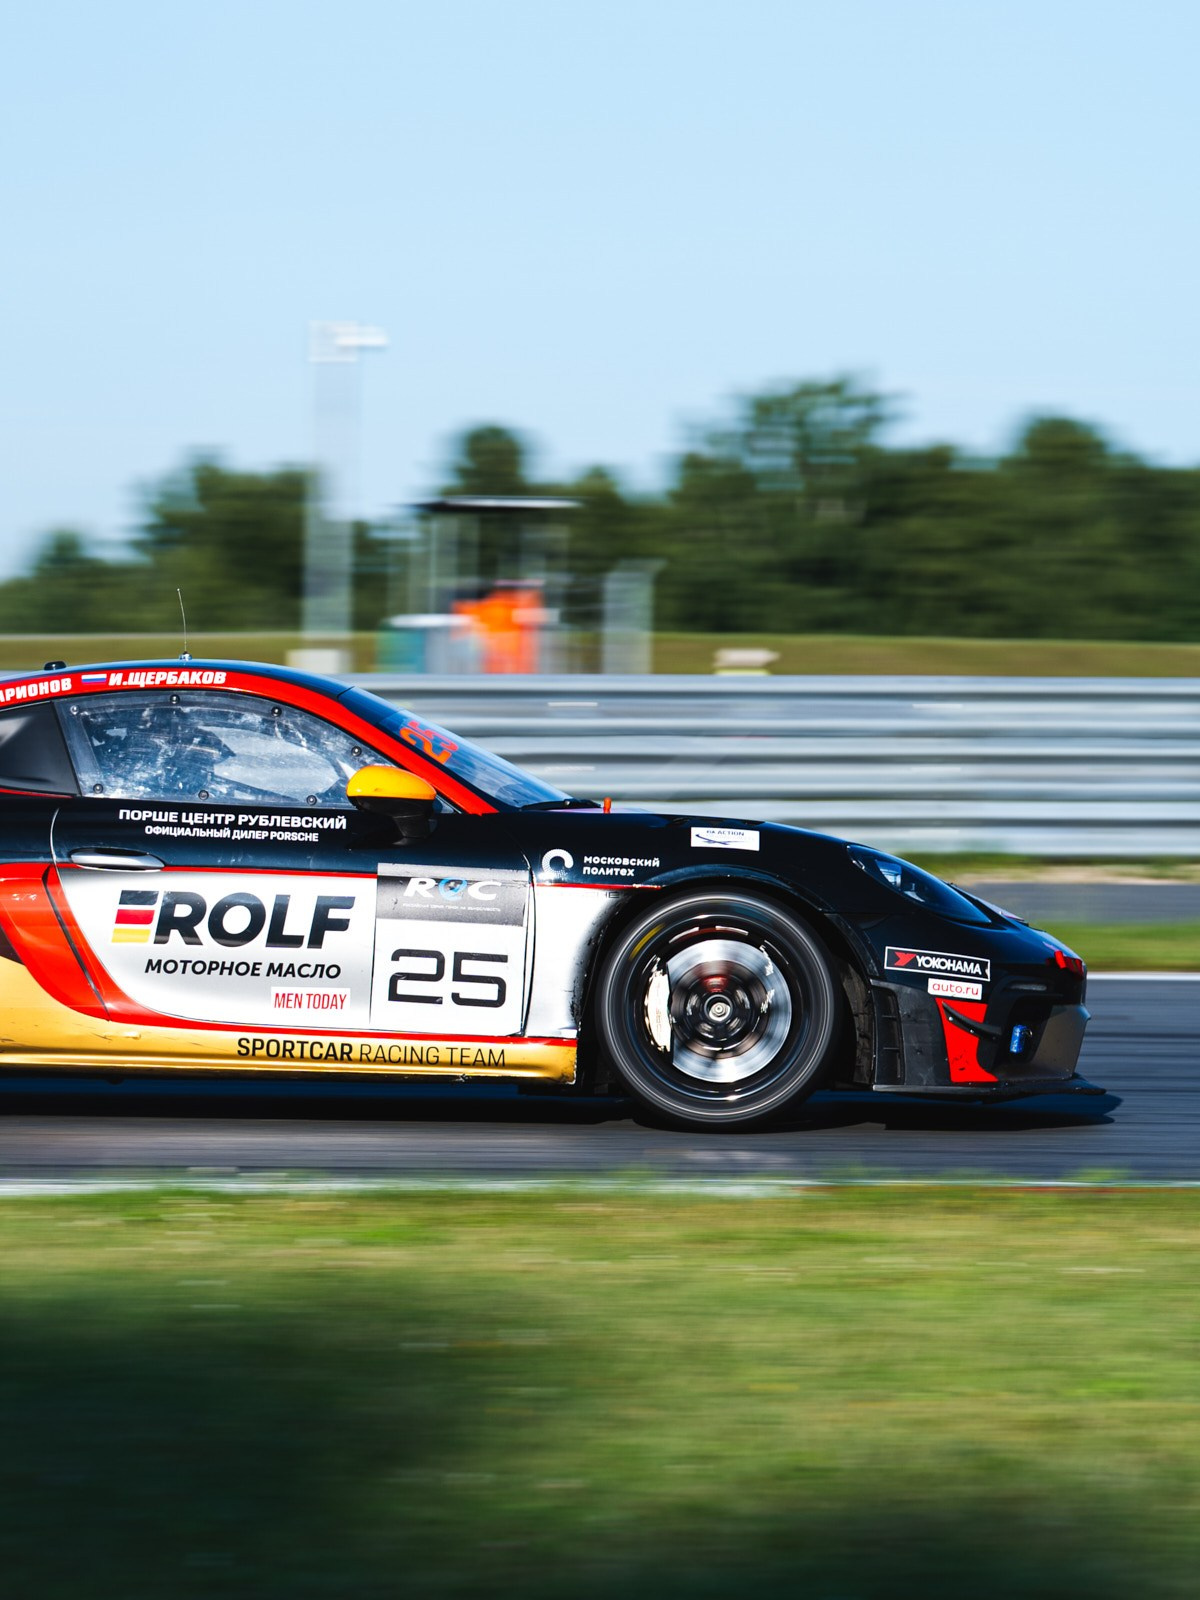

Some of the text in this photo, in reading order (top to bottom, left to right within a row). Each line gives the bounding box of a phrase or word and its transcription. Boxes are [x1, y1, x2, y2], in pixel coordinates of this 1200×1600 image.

[108, 671, 227, 687] И.ЩЕРБАКОВ
[119, 809, 347, 830] ПОРШЕ ЦЕНТР РУБЛЕВСКИЙ
[144, 825, 319, 842] ОФИЦИАЛЬНЫЙ ДИЛЕР PORSCHE
[153, 890, 356, 949] ROLF
[145, 959, 341, 979] МОТОРНОЕ МАСЛО
[916, 955, 982, 975] YOKOHAMA
[388, 949, 508, 1008] 25
[932, 983, 979, 996] auto.ru
[274, 992, 347, 1010] MEN TODAY
[237, 1038, 506, 1067] SPORTCAR RACING TEAM
